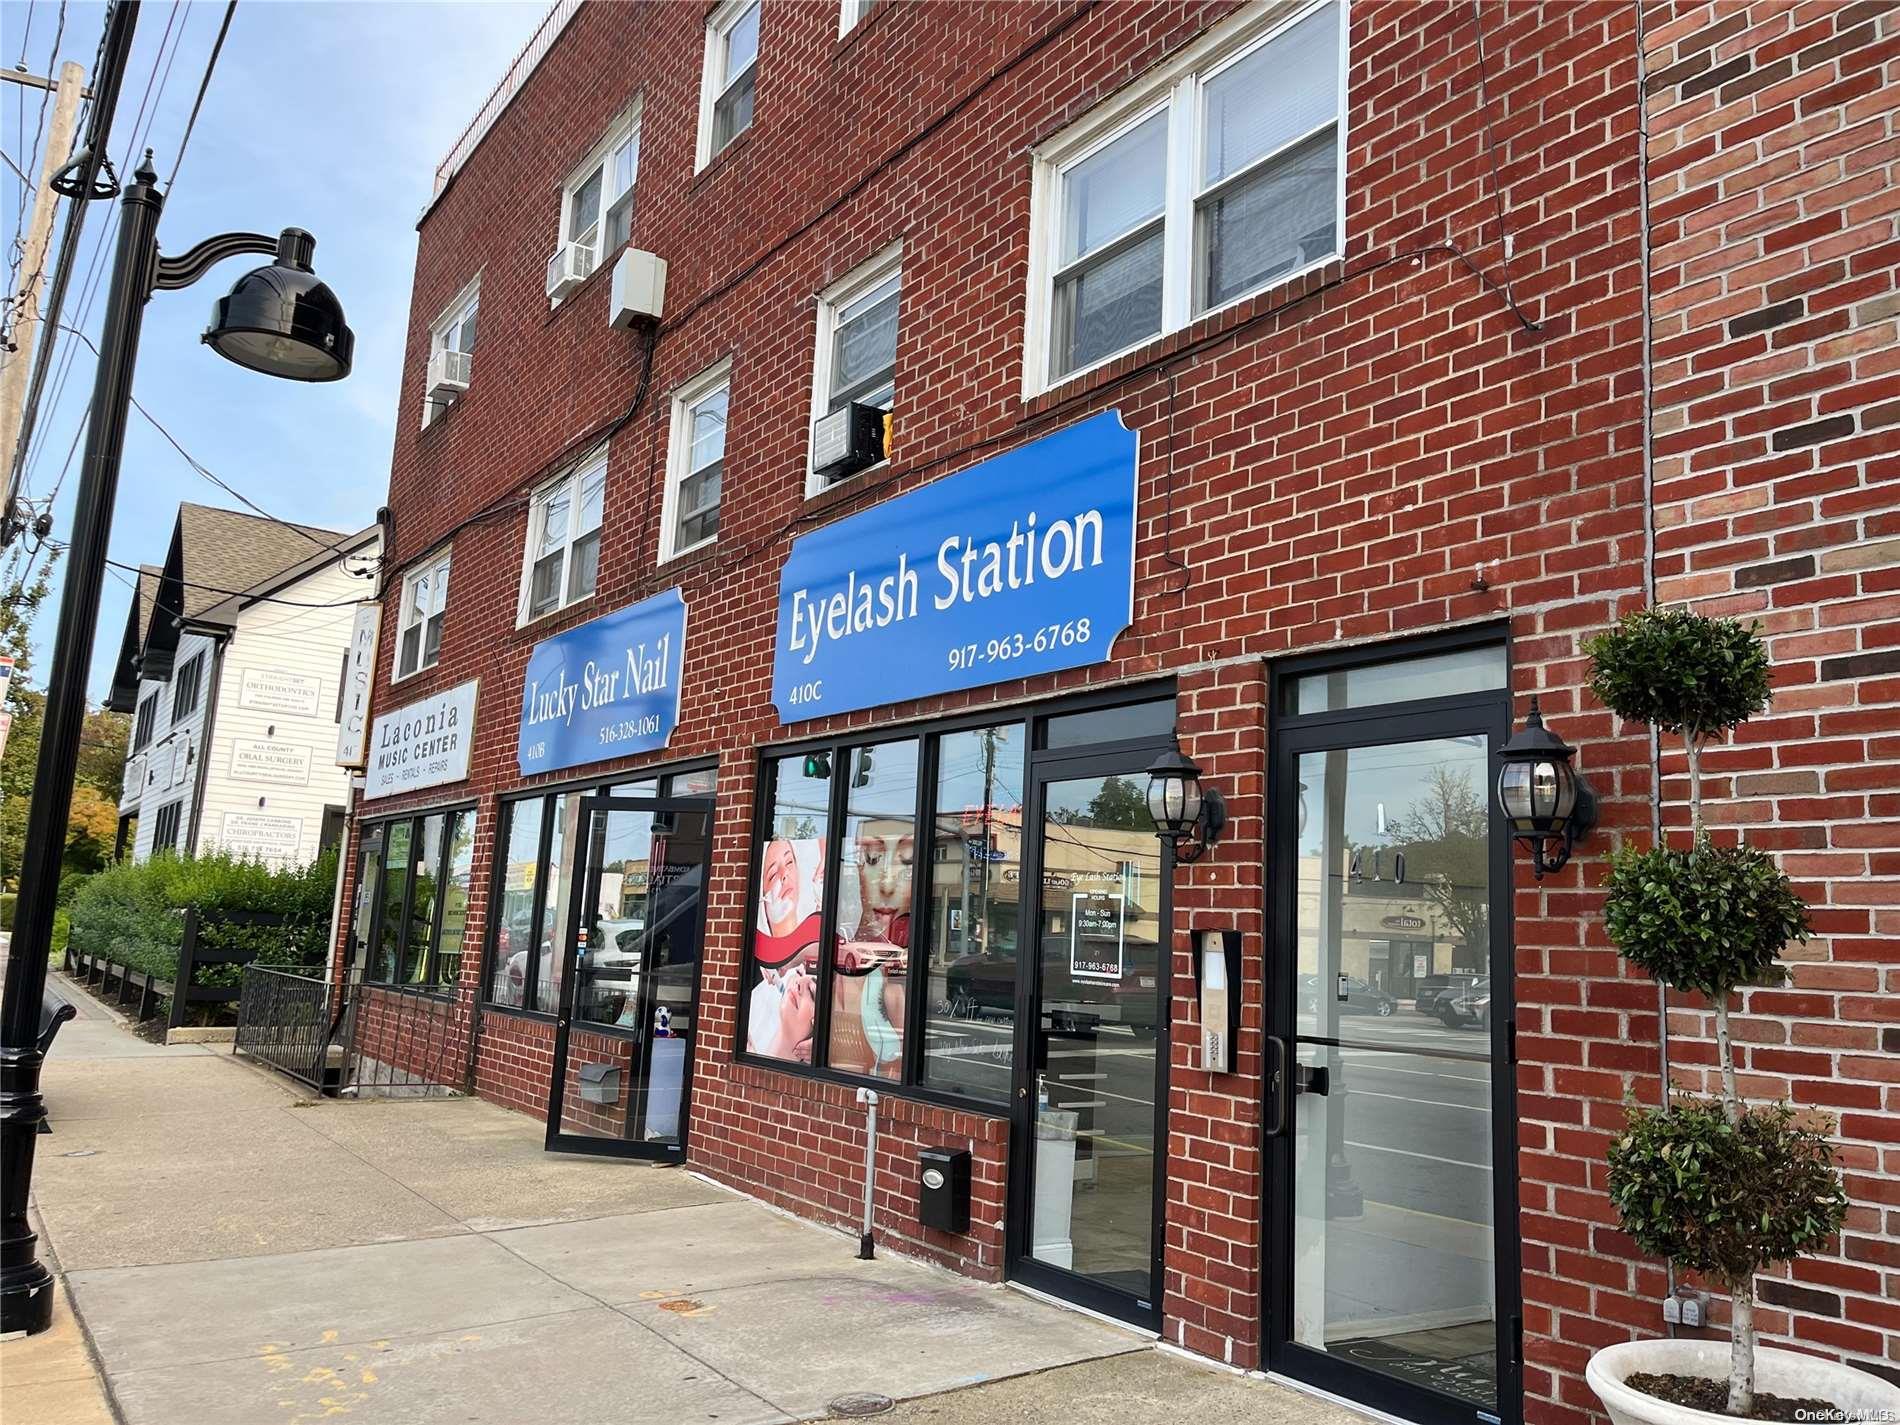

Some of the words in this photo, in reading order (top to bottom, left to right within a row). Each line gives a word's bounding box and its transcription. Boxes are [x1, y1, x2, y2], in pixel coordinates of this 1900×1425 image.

[789, 553, 919, 665] Eyelash
[933, 509, 1105, 611] Station
[948, 618, 1091, 671] 917-963-6768
[246, 681, 315, 697] ORTHODONTICS
[348, 628, 374, 734] MUSIC
[528, 670, 579, 726] Lucky
[581, 661, 619, 711] Star
[623, 632, 670, 699] Nail
[789, 681, 823, 705] 410C
[381, 703, 458, 749] Laconia
[599, 715, 660, 745] 516-328-1061
[378, 750, 408, 770] MUSIC
[414, 733, 458, 761] CENTER
[528, 742, 545, 760] 410B
[380, 773, 394, 786] SALES
[428, 759, 448, 775] REPAIRS
[1070, 872, 1084, 887] Eye
[1085, 909, 1097, 917] Mon
[1100, 909, 1111, 917] Sun
[1074, 961, 1119, 972] 917-963-6768
